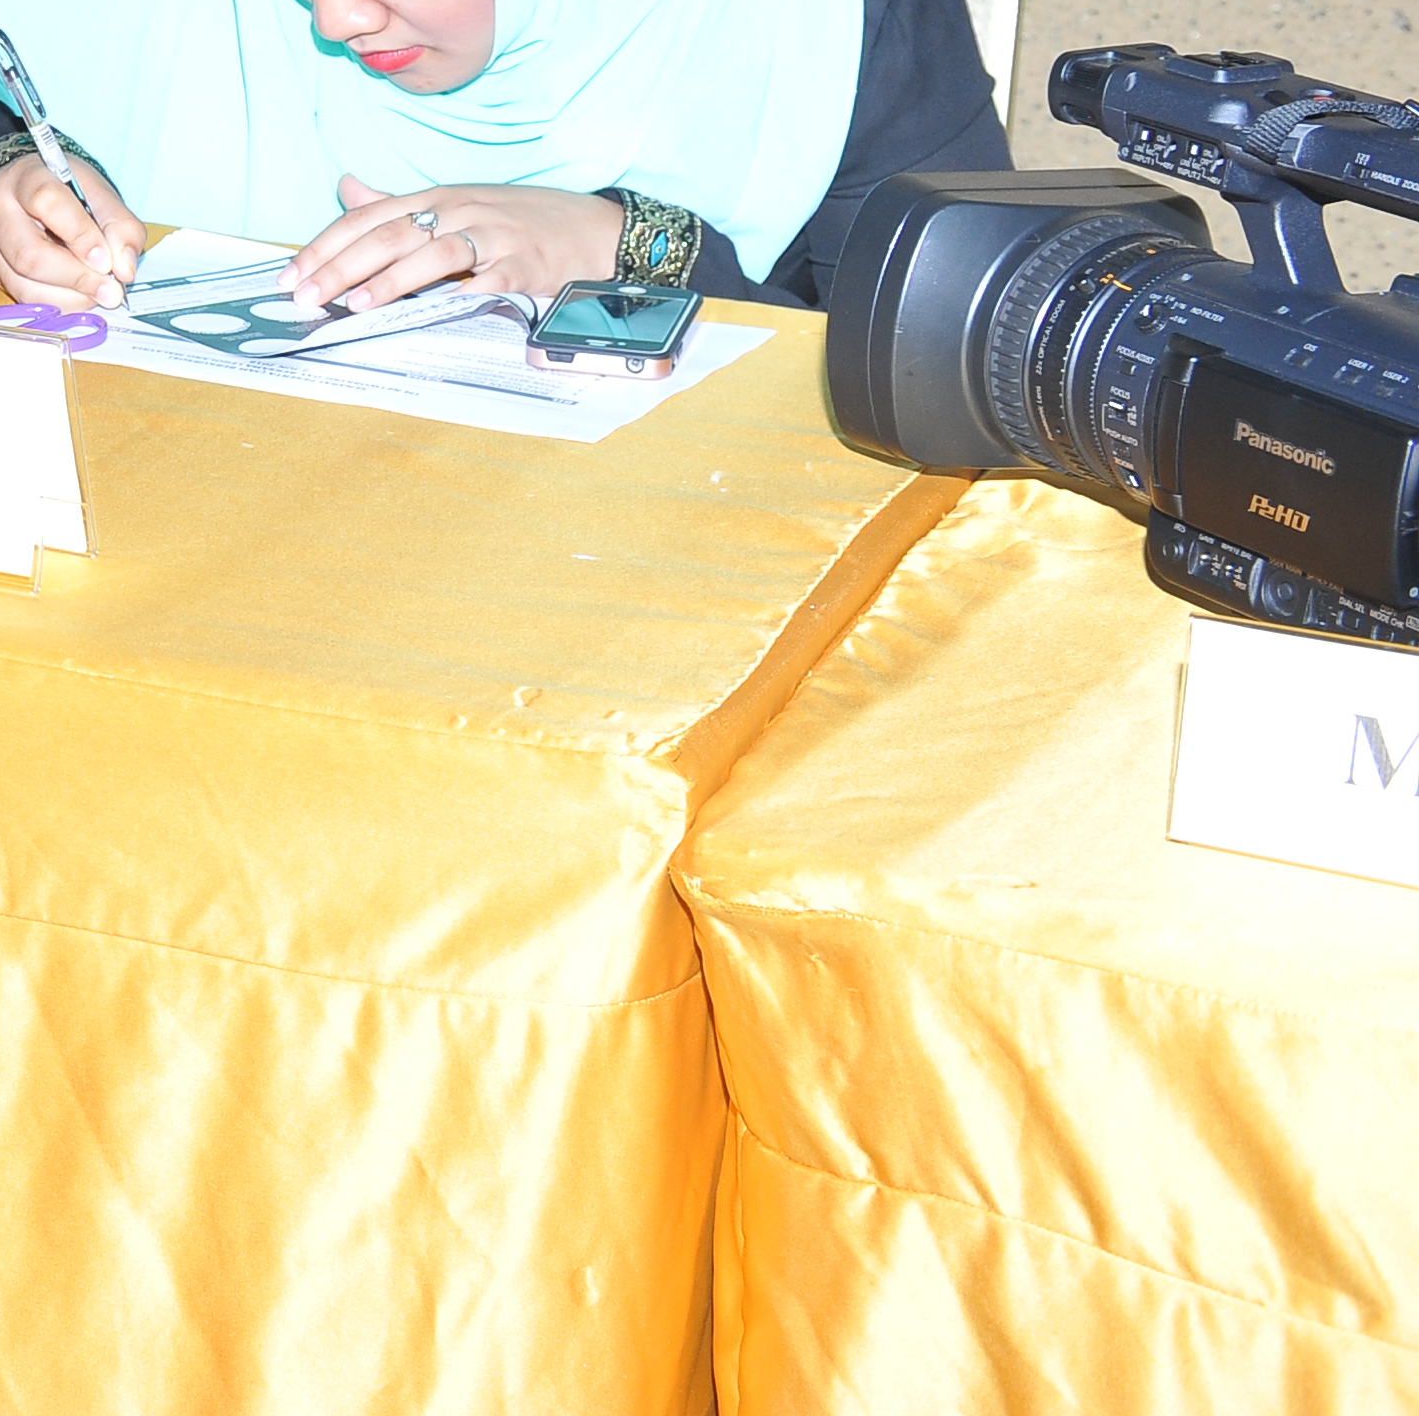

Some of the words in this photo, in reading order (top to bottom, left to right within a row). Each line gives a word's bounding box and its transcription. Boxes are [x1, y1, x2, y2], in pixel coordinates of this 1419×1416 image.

[1201, 310, 1225, 323] FILTER
[1037, 326, 1053, 360] OPTICAL
[1049, 299, 1066, 324] ZOOM
[1116, 345, 1135, 358] FOCUS
[1347, 358, 1369, 370] USER
[1382, 370, 1402, 382] USER
[1110, 386, 1132, 400] FOCUS
[1234, 419, 1335, 476] Panasonic
[1370, 609, 1391, 625] MODE
